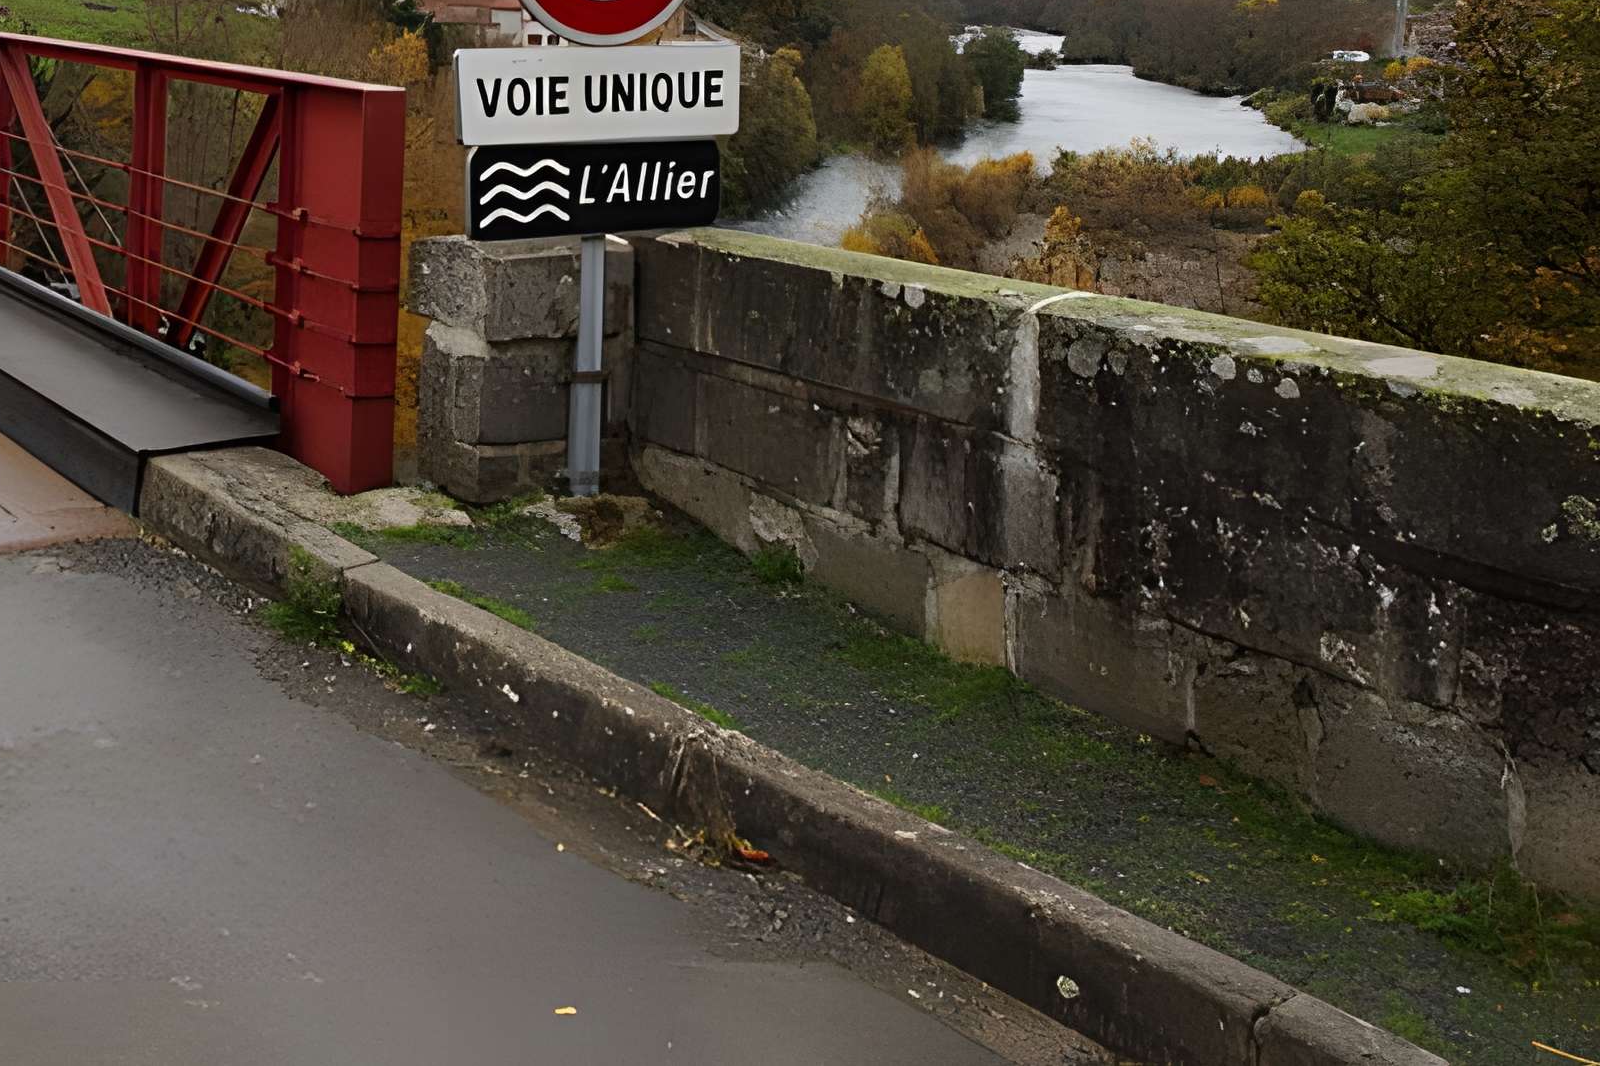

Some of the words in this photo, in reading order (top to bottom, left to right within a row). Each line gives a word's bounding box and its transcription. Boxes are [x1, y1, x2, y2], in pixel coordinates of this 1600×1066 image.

[476, 76, 570, 117] VOIE
[584, 70, 724, 113] UNIQUE
[578, 161, 715, 204] L'Allier
